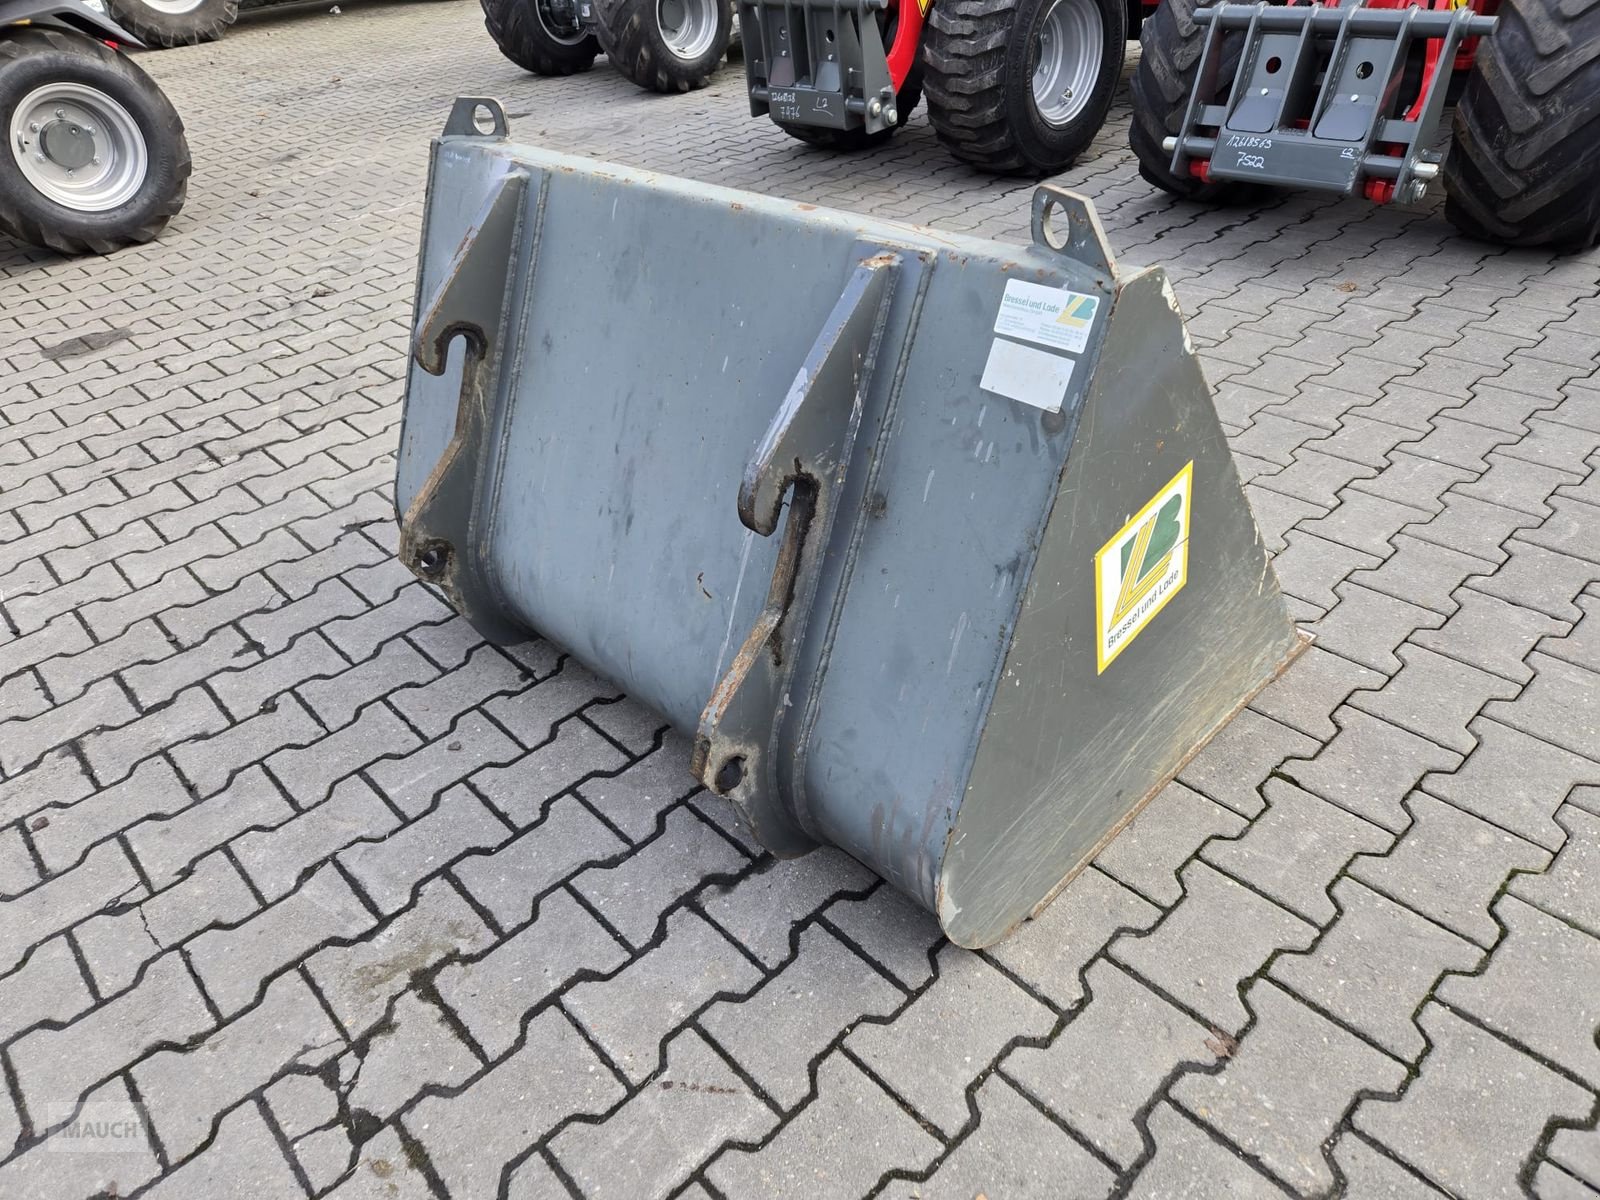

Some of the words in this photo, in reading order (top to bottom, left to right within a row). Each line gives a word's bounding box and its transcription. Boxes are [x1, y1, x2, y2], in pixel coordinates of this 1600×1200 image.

[1004, 293, 1029, 307] Bressel
[1028, 300, 1042, 310] und
[1108, 607, 1140, 648] Bressel
[1141, 589, 1158, 614] und
[1158, 568, 1179, 596] Lode
